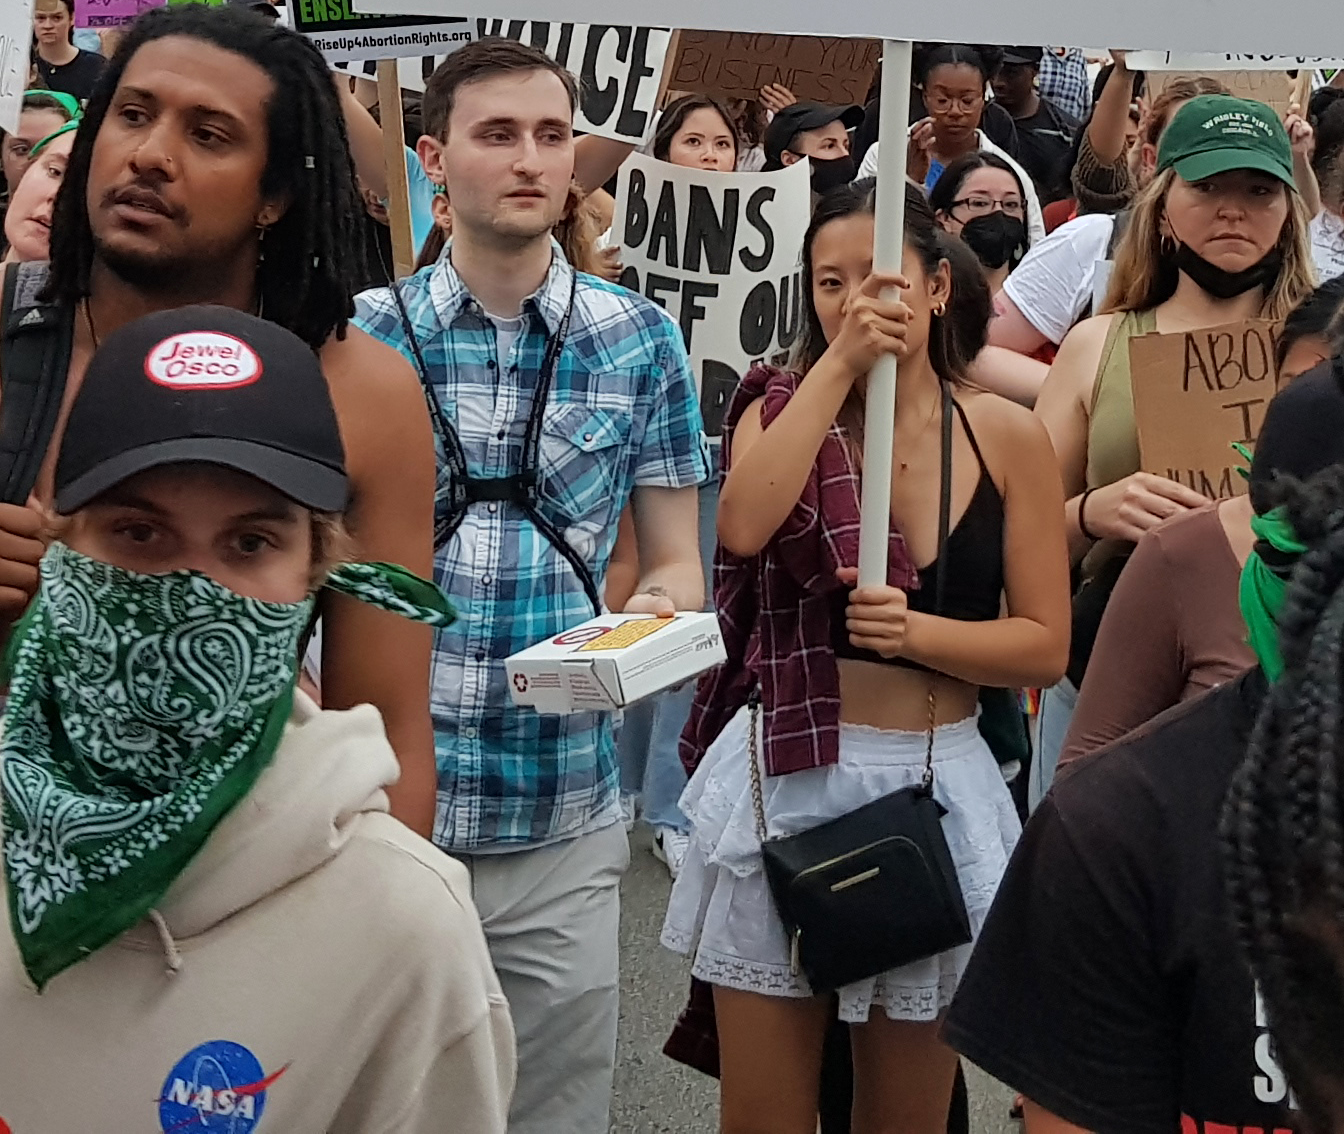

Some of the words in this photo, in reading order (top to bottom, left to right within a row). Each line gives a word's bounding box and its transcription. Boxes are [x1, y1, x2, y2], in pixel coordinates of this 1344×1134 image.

[314, 31, 472, 52] RiseUp4AbortionRights.org
[673, 47, 859, 106] BUSINESS
[624, 168, 776, 275] BANS
[159, 342, 242, 361] Jewel
[165, 360, 240, 378] Osco
[167, 1078, 254, 1120] NASA
